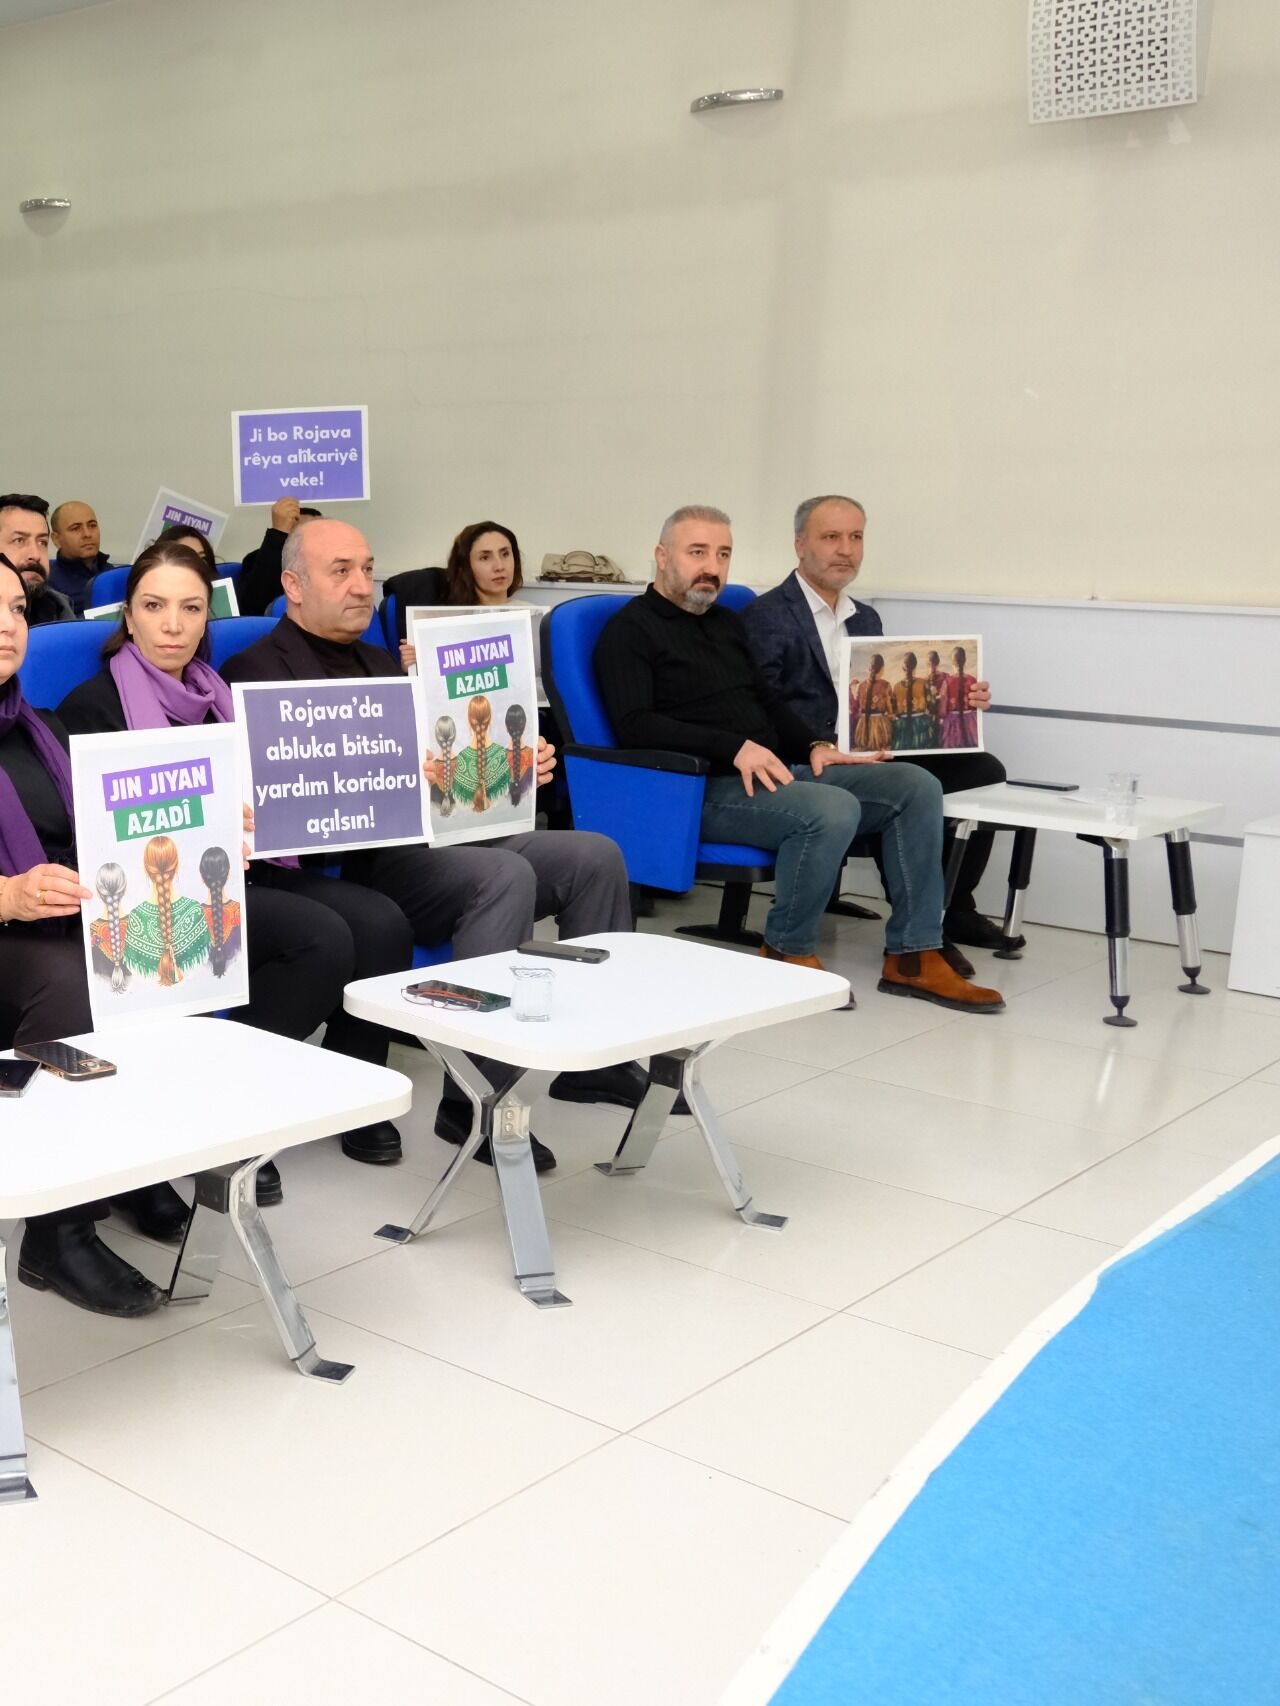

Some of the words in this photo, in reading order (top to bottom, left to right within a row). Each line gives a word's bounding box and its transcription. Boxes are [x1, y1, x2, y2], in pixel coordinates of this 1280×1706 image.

[249, 427, 263, 443] Ji
[267, 426, 288, 442] bo
[292, 425, 352, 444] Rojava
[243, 452, 282, 469] rêya
[287, 447, 359, 466] alîkariyê
[279, 470, 324, 488] veke!
[165, 509, 182, 522] JIN
[181, 514, 210, 532] JIYAN
[442, 647, 466, 669] JIN
[469, 640, 510, 664] JIYAN
[455, 666, 500, 696] AZADÎ
[265, 736, 337, 761] abluka
[341, 733, 403, 757] bitsin,
[110, 775, 143, 802] JIN
[148, 765, 208, 796] JIYAN
[255, 773, 329, 807] yardım
[333, 767, 417, 794] koridoru
[127, 798, 192, 836] AZADÎ
[306, 806, 376, 839] açılsın!
